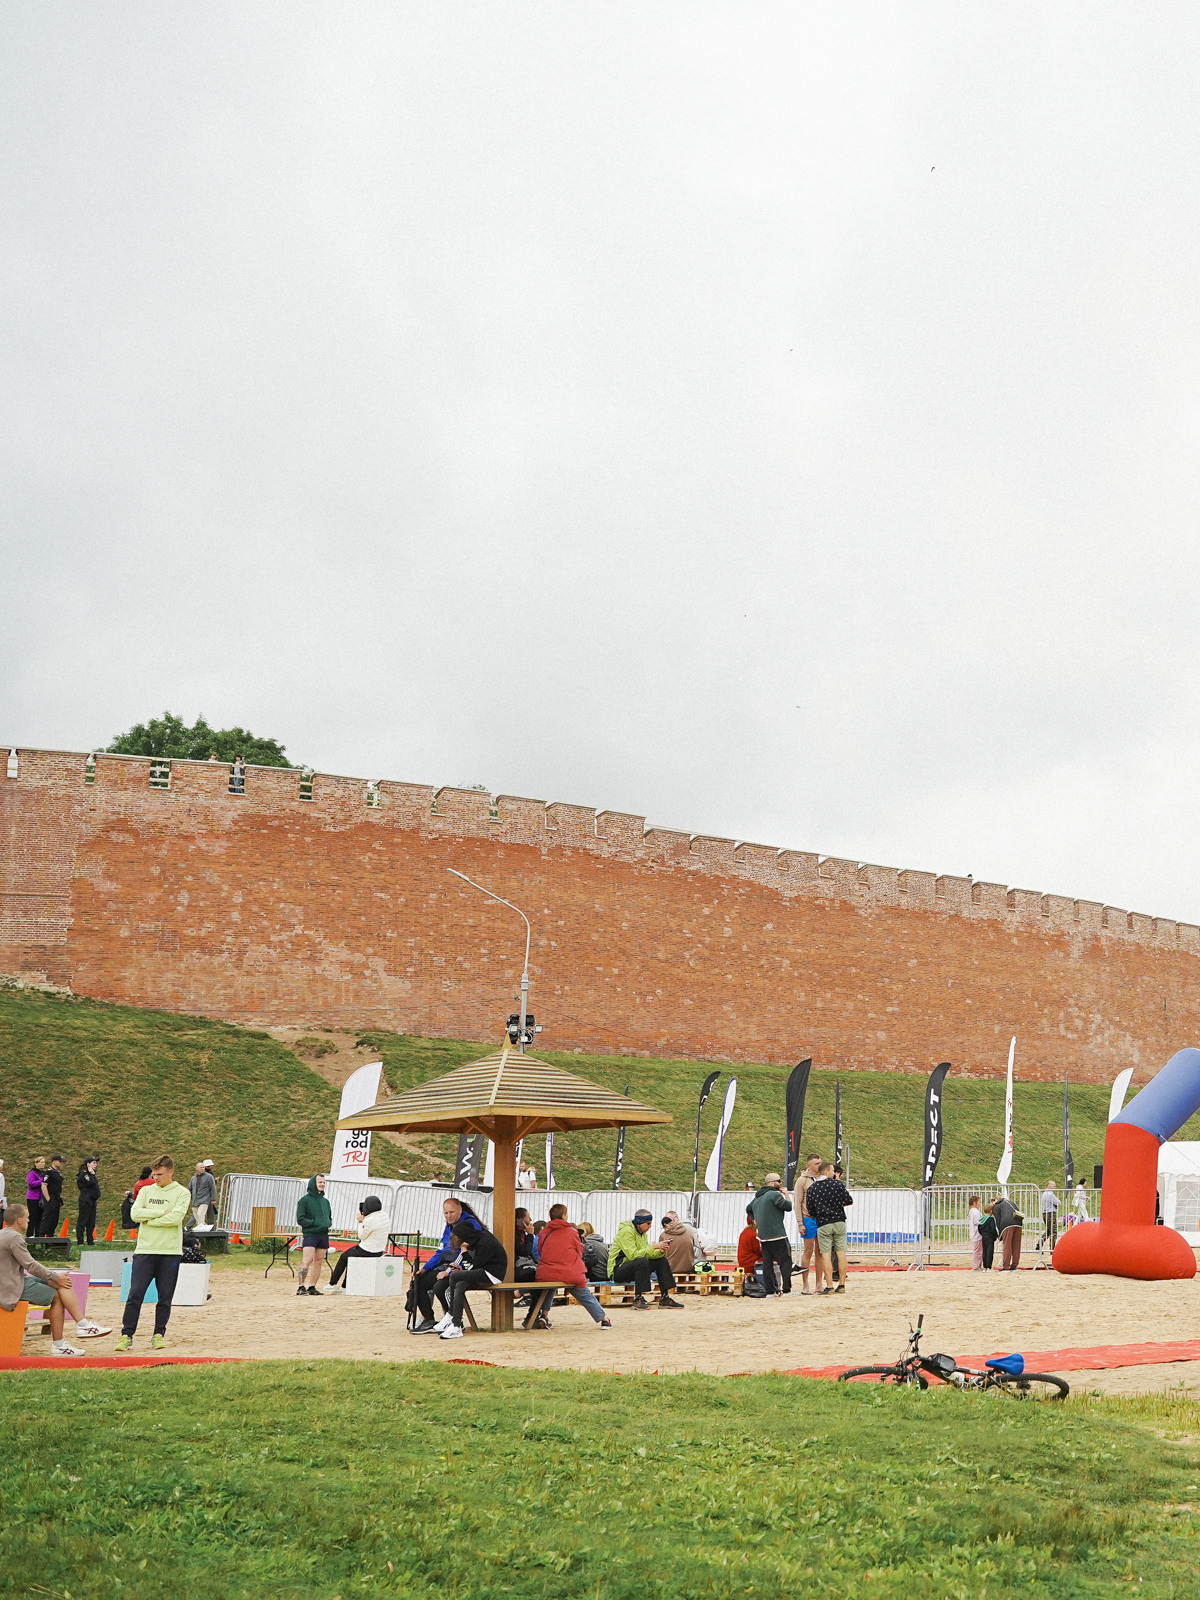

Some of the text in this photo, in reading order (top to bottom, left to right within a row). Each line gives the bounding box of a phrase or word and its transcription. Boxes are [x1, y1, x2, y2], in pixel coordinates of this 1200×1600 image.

[352, 1130, 369, 1139] go
[345, 1136, 368, 1148] rod
[343, 1151, 367, 1162] TRI
